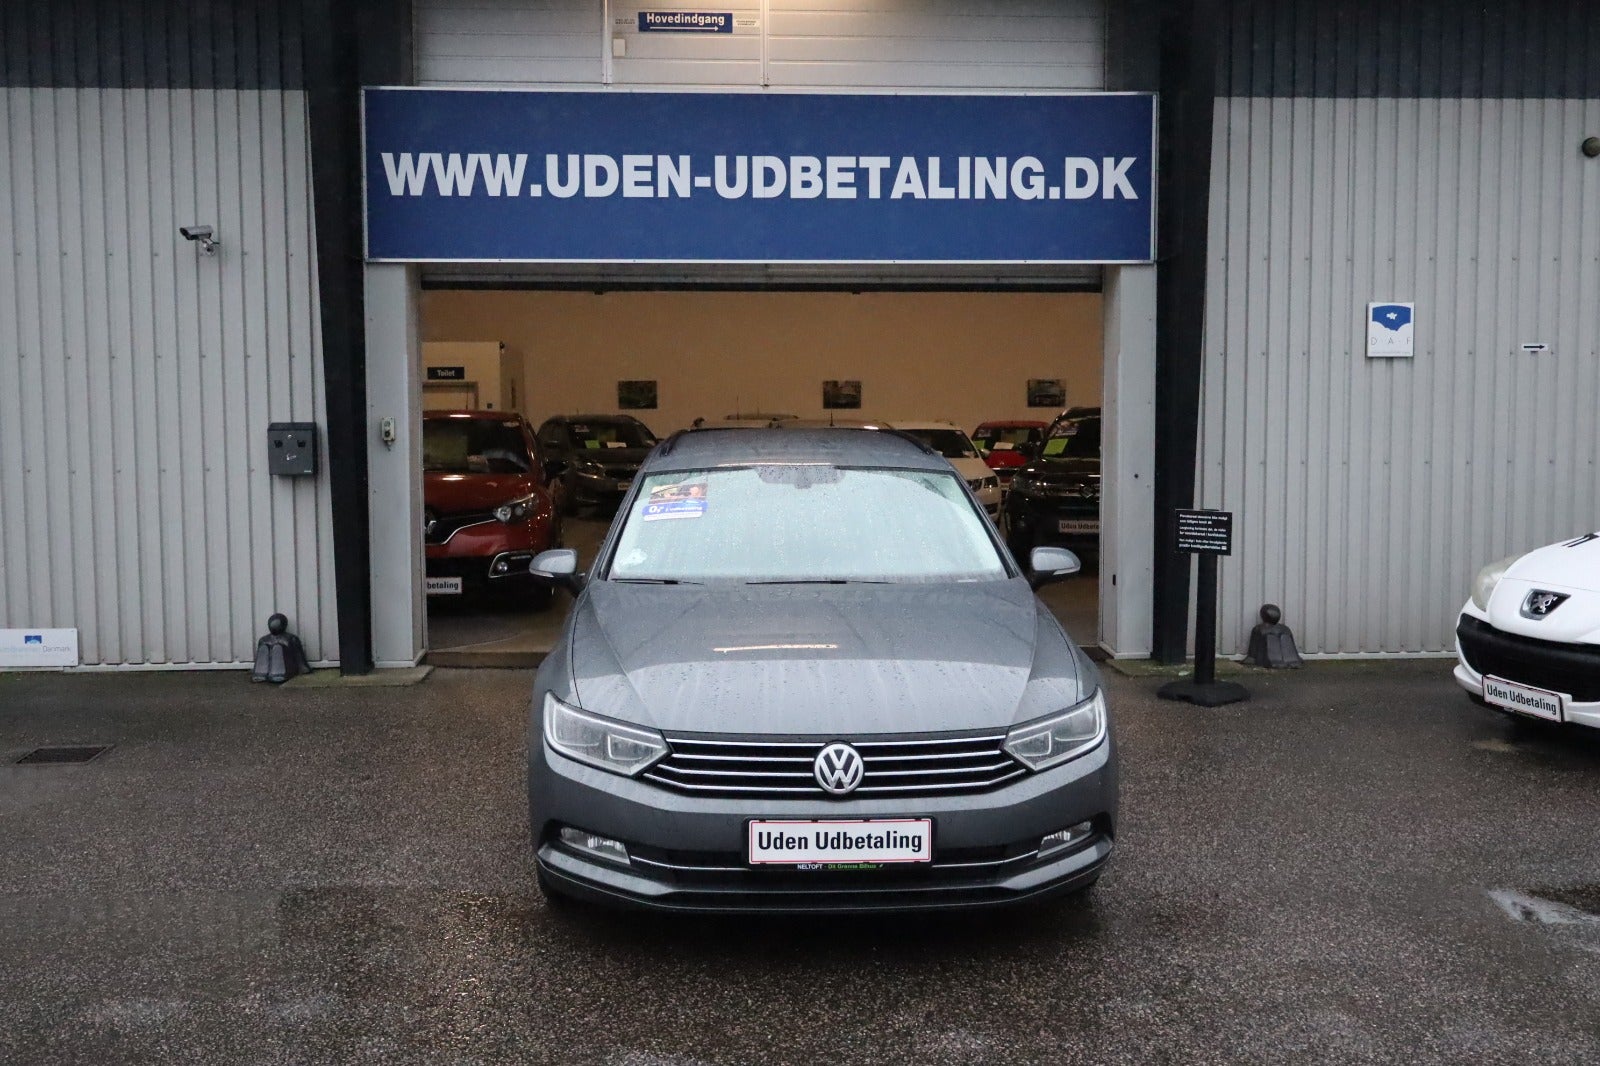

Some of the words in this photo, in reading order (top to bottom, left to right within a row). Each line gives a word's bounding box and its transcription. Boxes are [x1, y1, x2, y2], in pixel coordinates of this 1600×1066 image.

[646, 12, 725, 26] Hovedindgang
[380, 151, 1138, 201] WWW.UDEN-UDBETALING.DK
[1487, 684, 1508, 700] Uden
[1509, 690, 1557, 715] Udbetaling
[758, 831, 809, 850] Uden
[815, 830, 922, 852] Udbetaling
